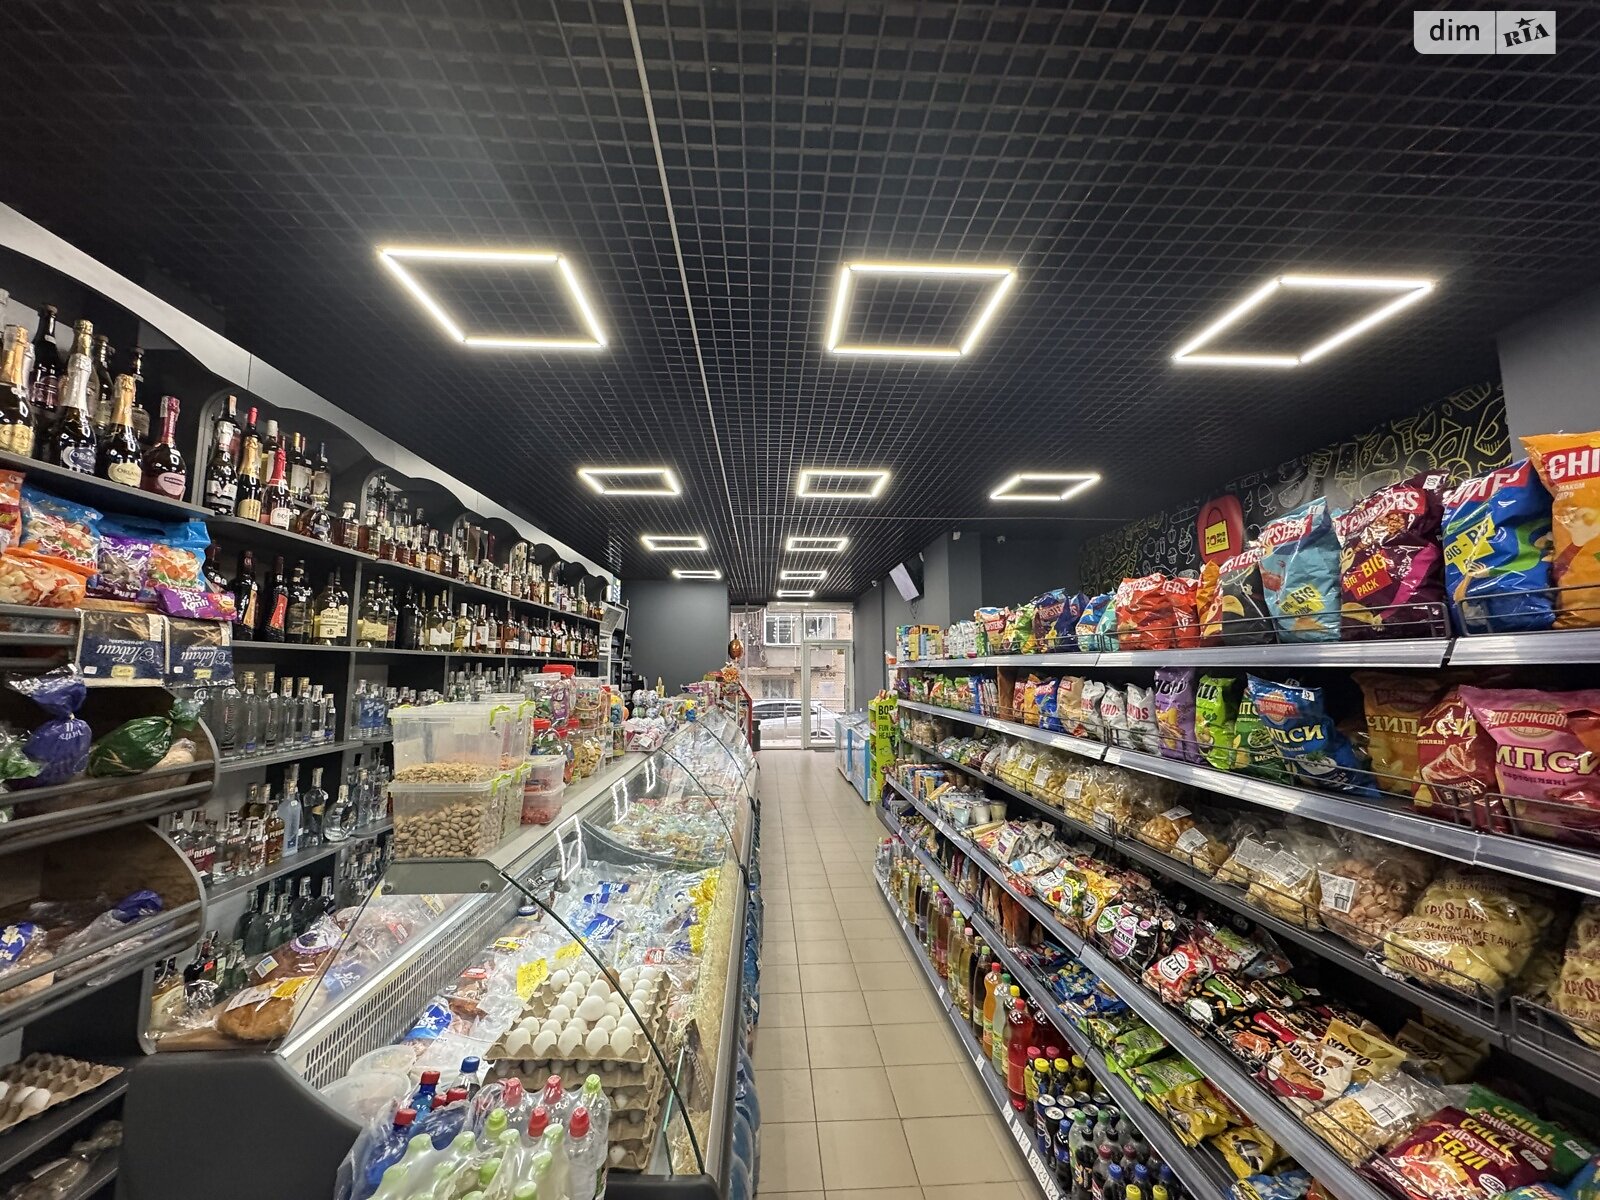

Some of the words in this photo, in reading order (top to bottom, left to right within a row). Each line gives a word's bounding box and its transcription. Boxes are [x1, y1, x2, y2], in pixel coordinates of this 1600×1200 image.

[1446, 544, 1462, 561] BIG
[1360, 553, 1386, 578] BIG
[1356, 577, 1379, 597] PACK
[1480, 1112, 1551, 1156] CHIPSTERS
